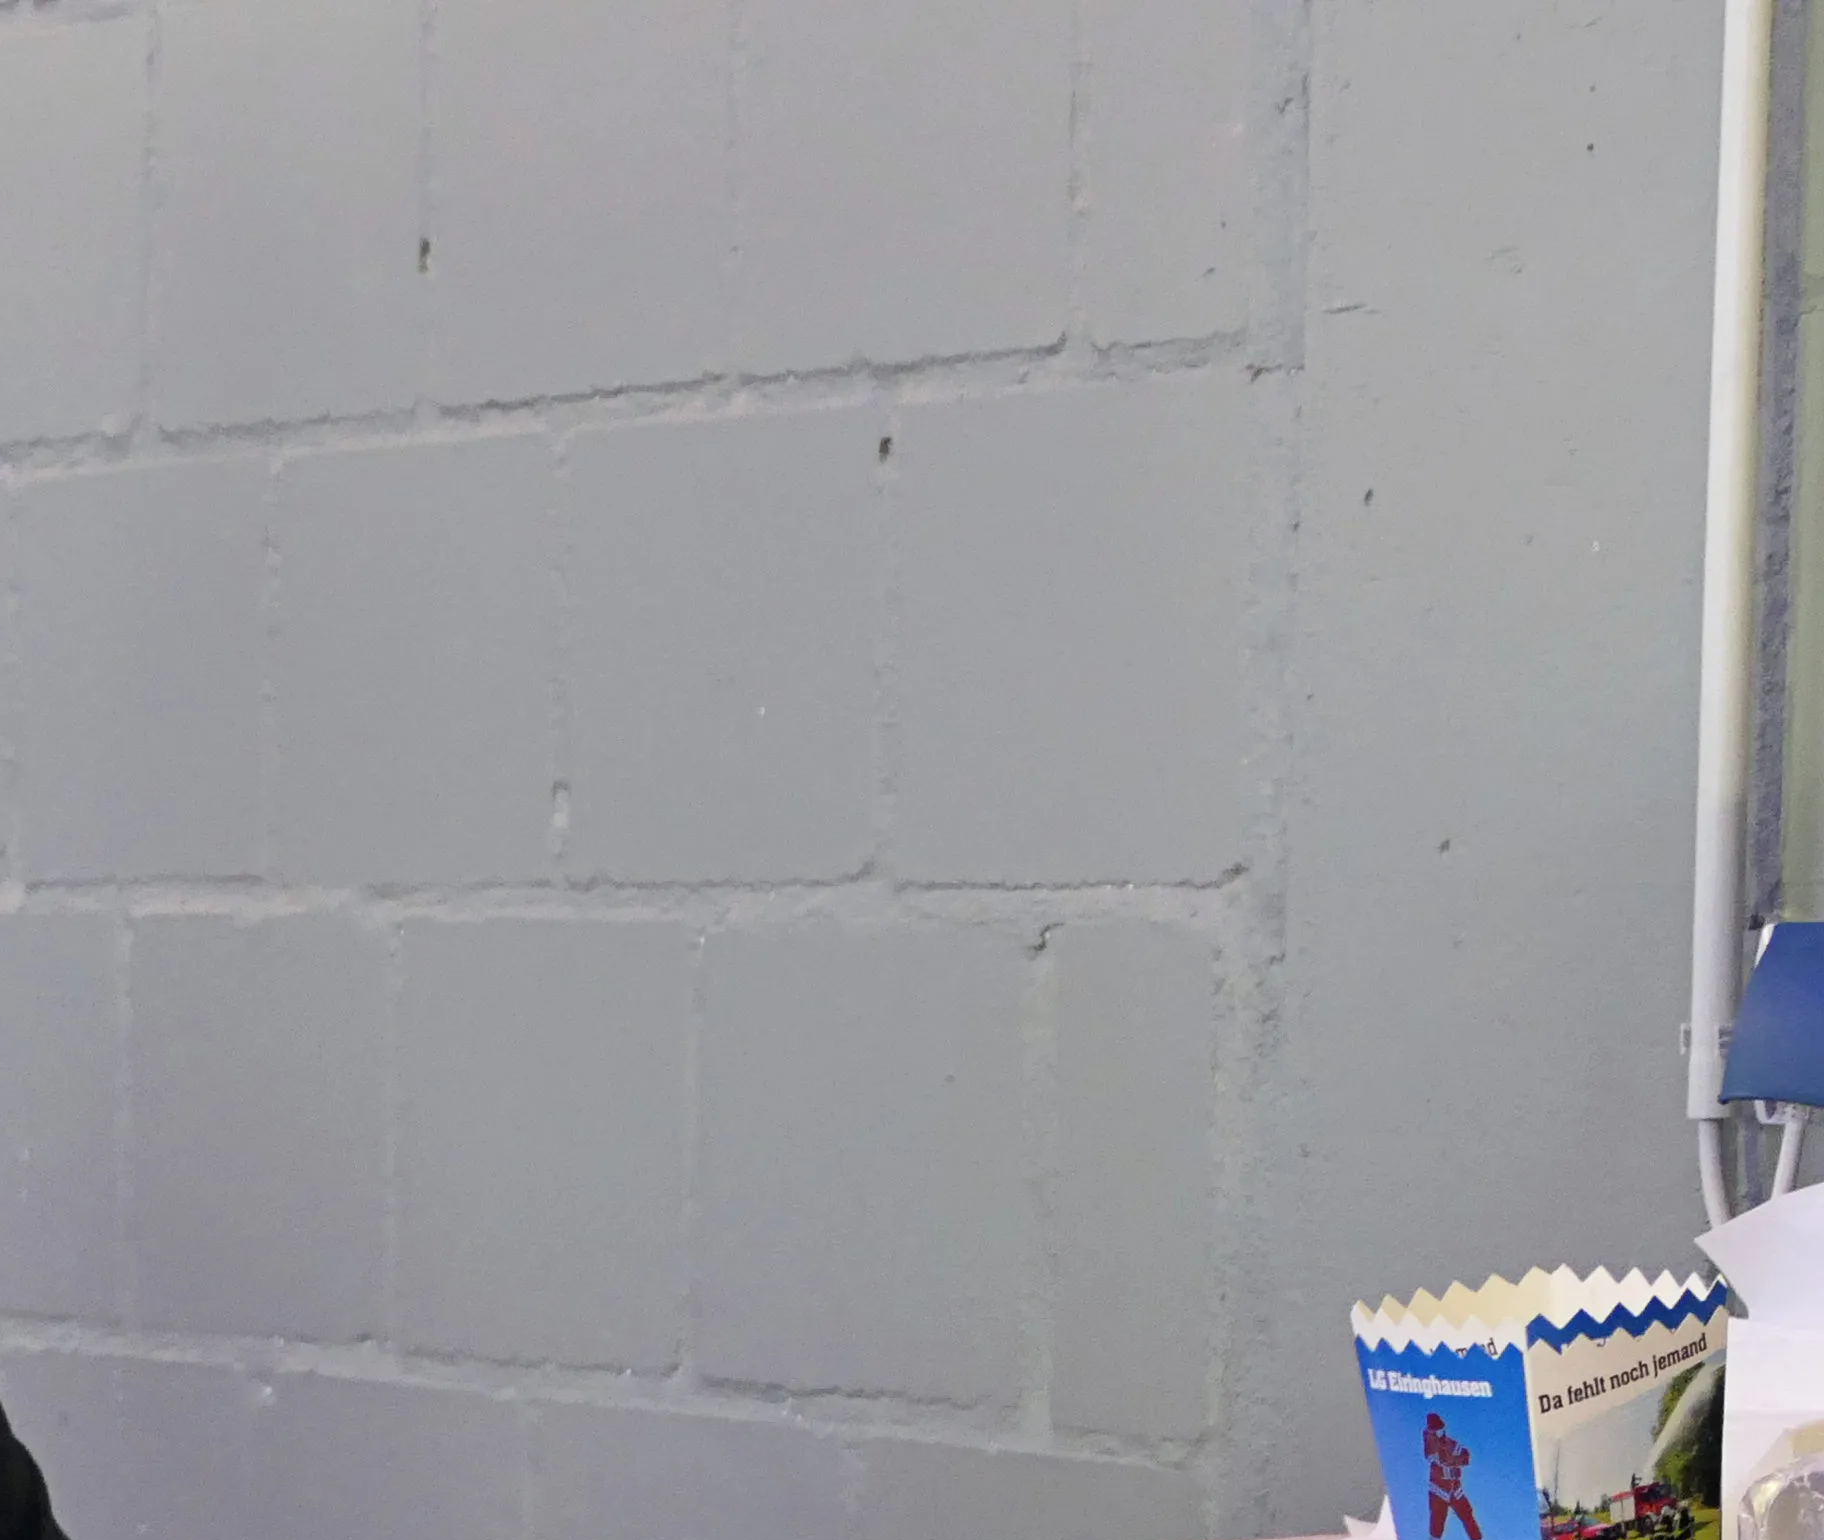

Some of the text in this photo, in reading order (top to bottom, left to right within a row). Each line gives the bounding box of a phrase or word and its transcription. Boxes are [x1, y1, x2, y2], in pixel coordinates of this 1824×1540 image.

[1367, 1368, 1388, 1391] LG
[1538, 1332, 1708, 1414] Da fehlt noch jemand
